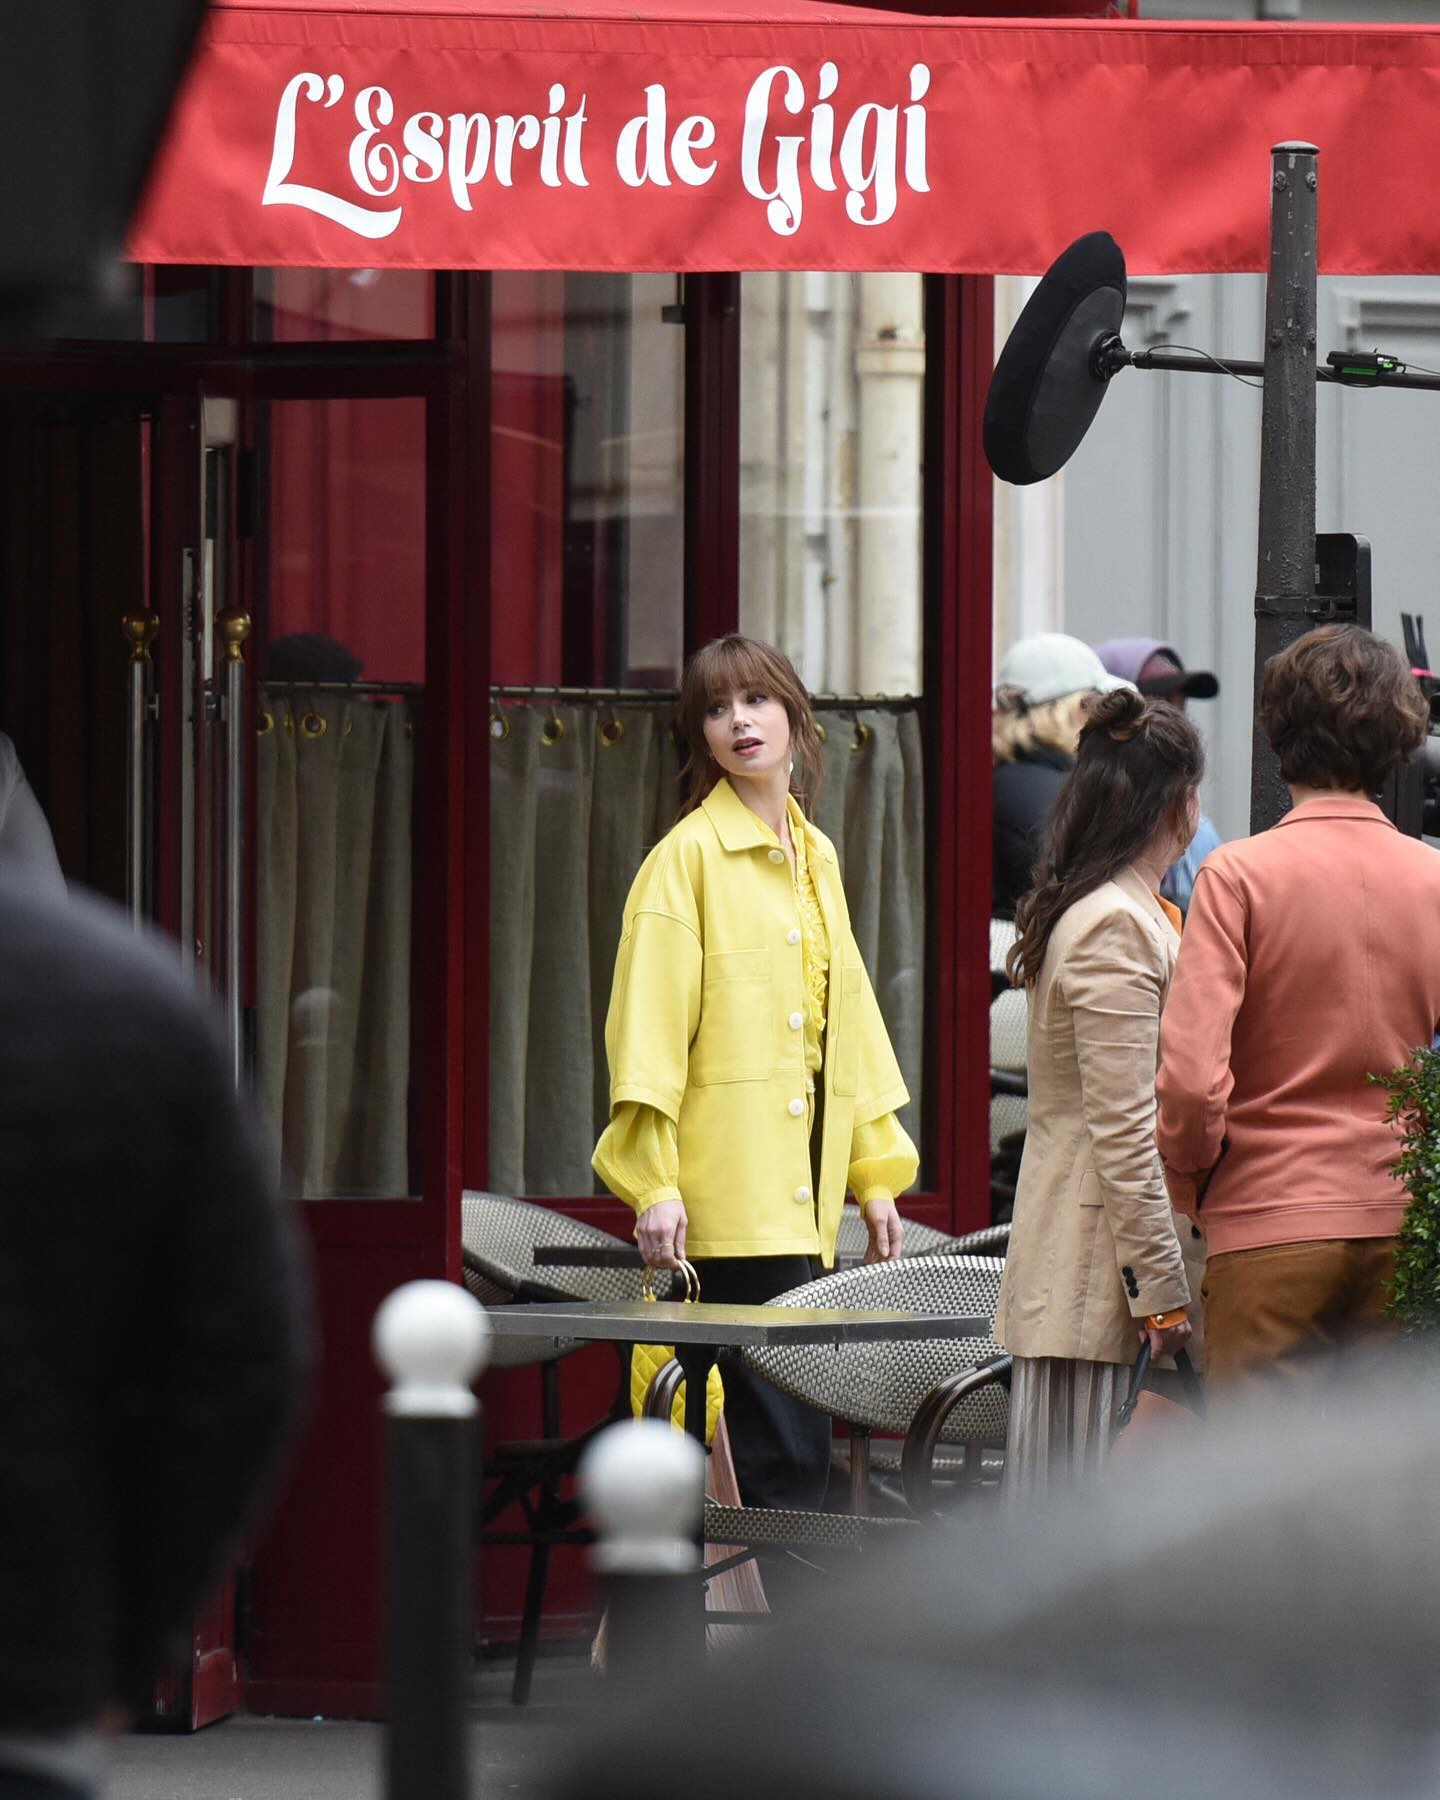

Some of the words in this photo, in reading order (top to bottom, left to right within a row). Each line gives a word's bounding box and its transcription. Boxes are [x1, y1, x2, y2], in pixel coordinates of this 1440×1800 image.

[261, 72, 590, 239] L'Esprit
[615, 83, 718, 188] de
[741, 61, 931, 237] Gigi
